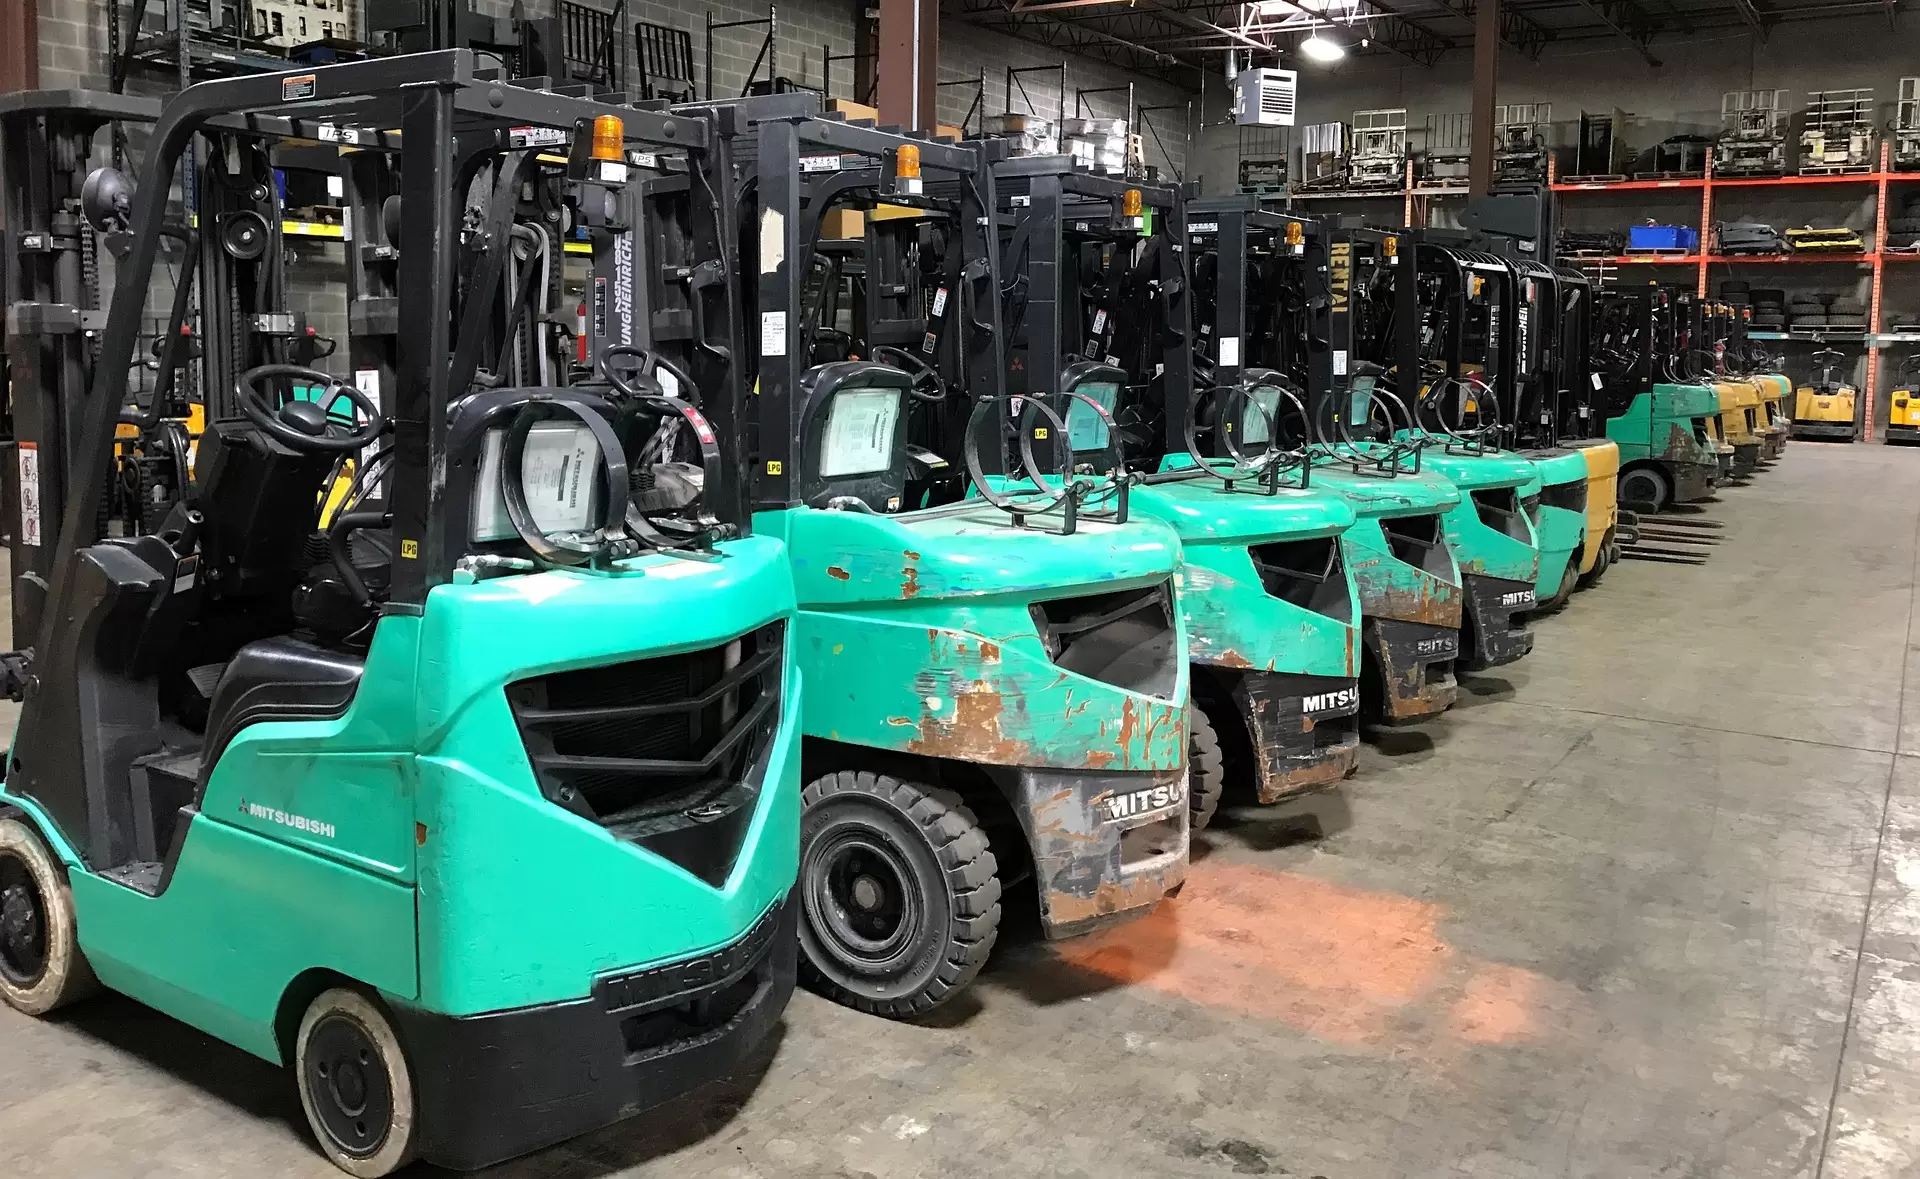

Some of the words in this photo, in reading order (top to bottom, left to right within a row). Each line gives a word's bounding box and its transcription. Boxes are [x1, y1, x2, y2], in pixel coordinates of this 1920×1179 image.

[621, 237, 633, 345] UNGHEINRICH
[768, 463, 781, 472] LPG
[402, 543, 417, 555] LPG
[1502, 590, 1536, 606] MITSU
[1302, 687, 1358, 713] MITSU
[1103, 783, 1181, 819] MITSU
[249, 802, 335, 838] MITSUBISHI
